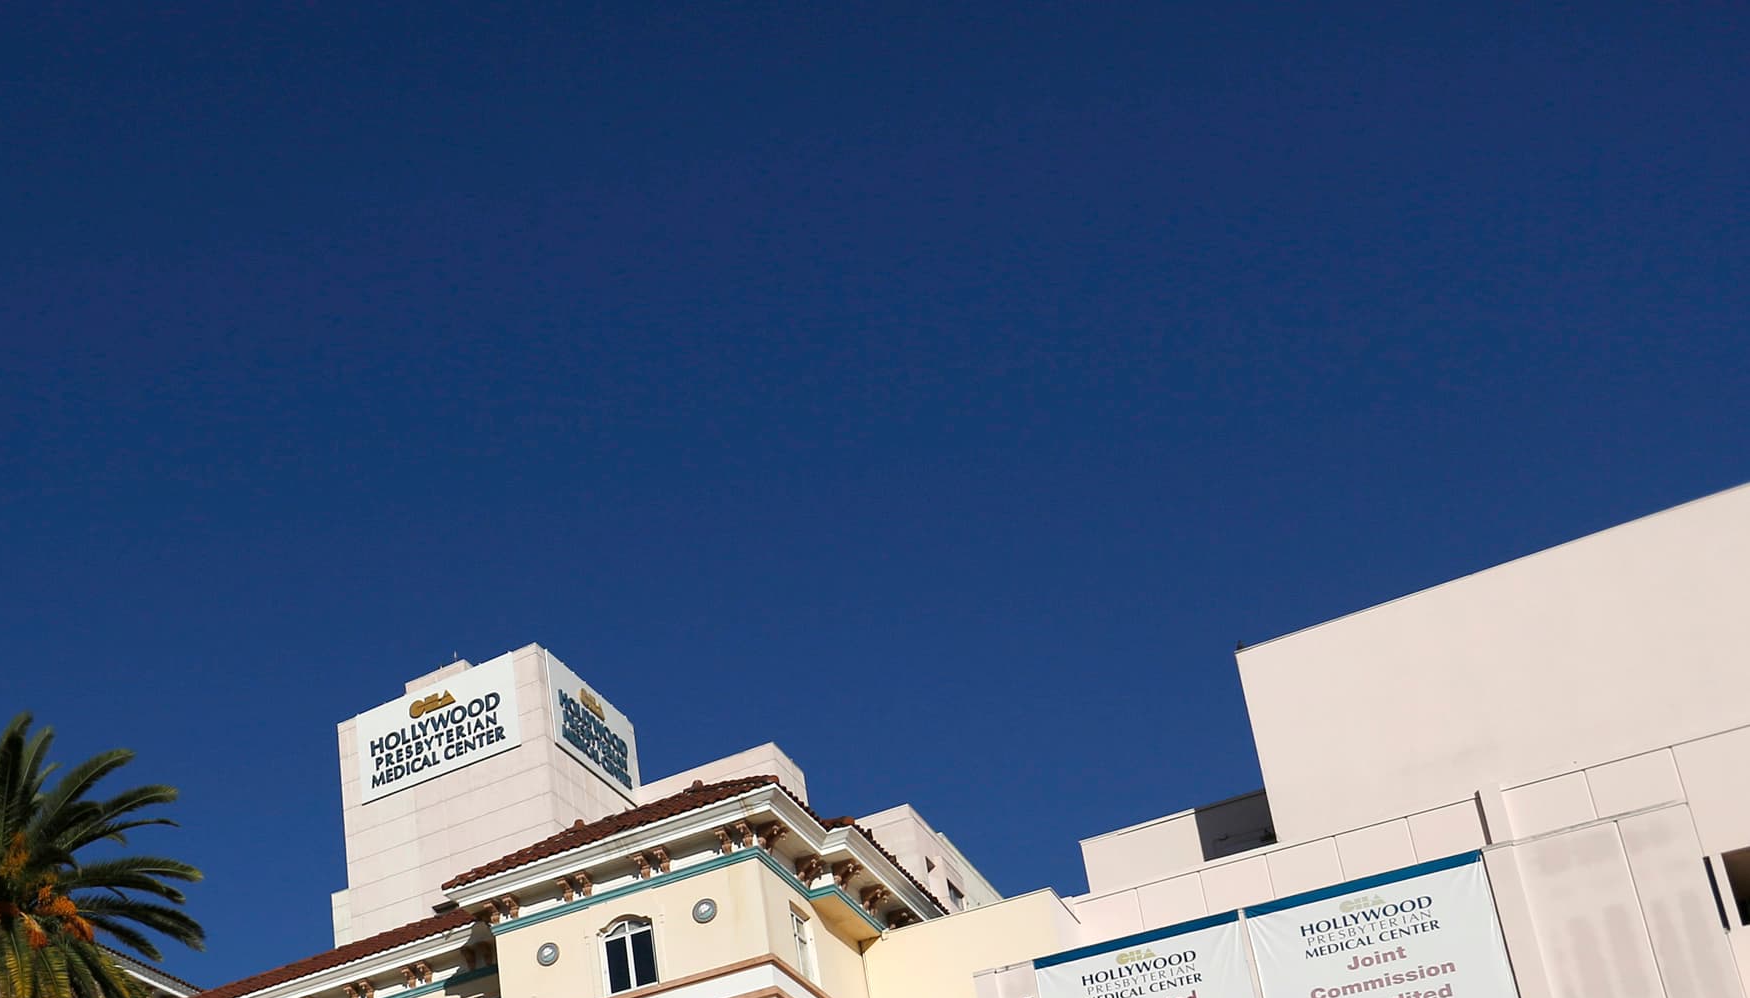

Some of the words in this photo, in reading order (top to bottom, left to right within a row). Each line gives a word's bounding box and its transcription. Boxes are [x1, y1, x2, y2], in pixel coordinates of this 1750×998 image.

[370, 692, 501, 757] HOLLYWOOD
[375, 711, 498, 771] PRESBYTERIAN
[372, 751, 440, 789] MEDICAL
[444, 726, 506, 760] CENTER
[1300, 895, 1433, 937] HOLLYWOOD
[1307, 909, 1432, 947] PRESBYTERIAN
[1305, 935, 1375, 959] MEDICAL
[1379, 919, 1440, 943] CENTER
[1347, 946, 1407, 971] Joint
[1081, 950, 1197, 987] HOLLYWOOD
[1087, 963, 1196, 996] PRESBYTERIAN
[1149, 972, 1203, 993] CENTER
